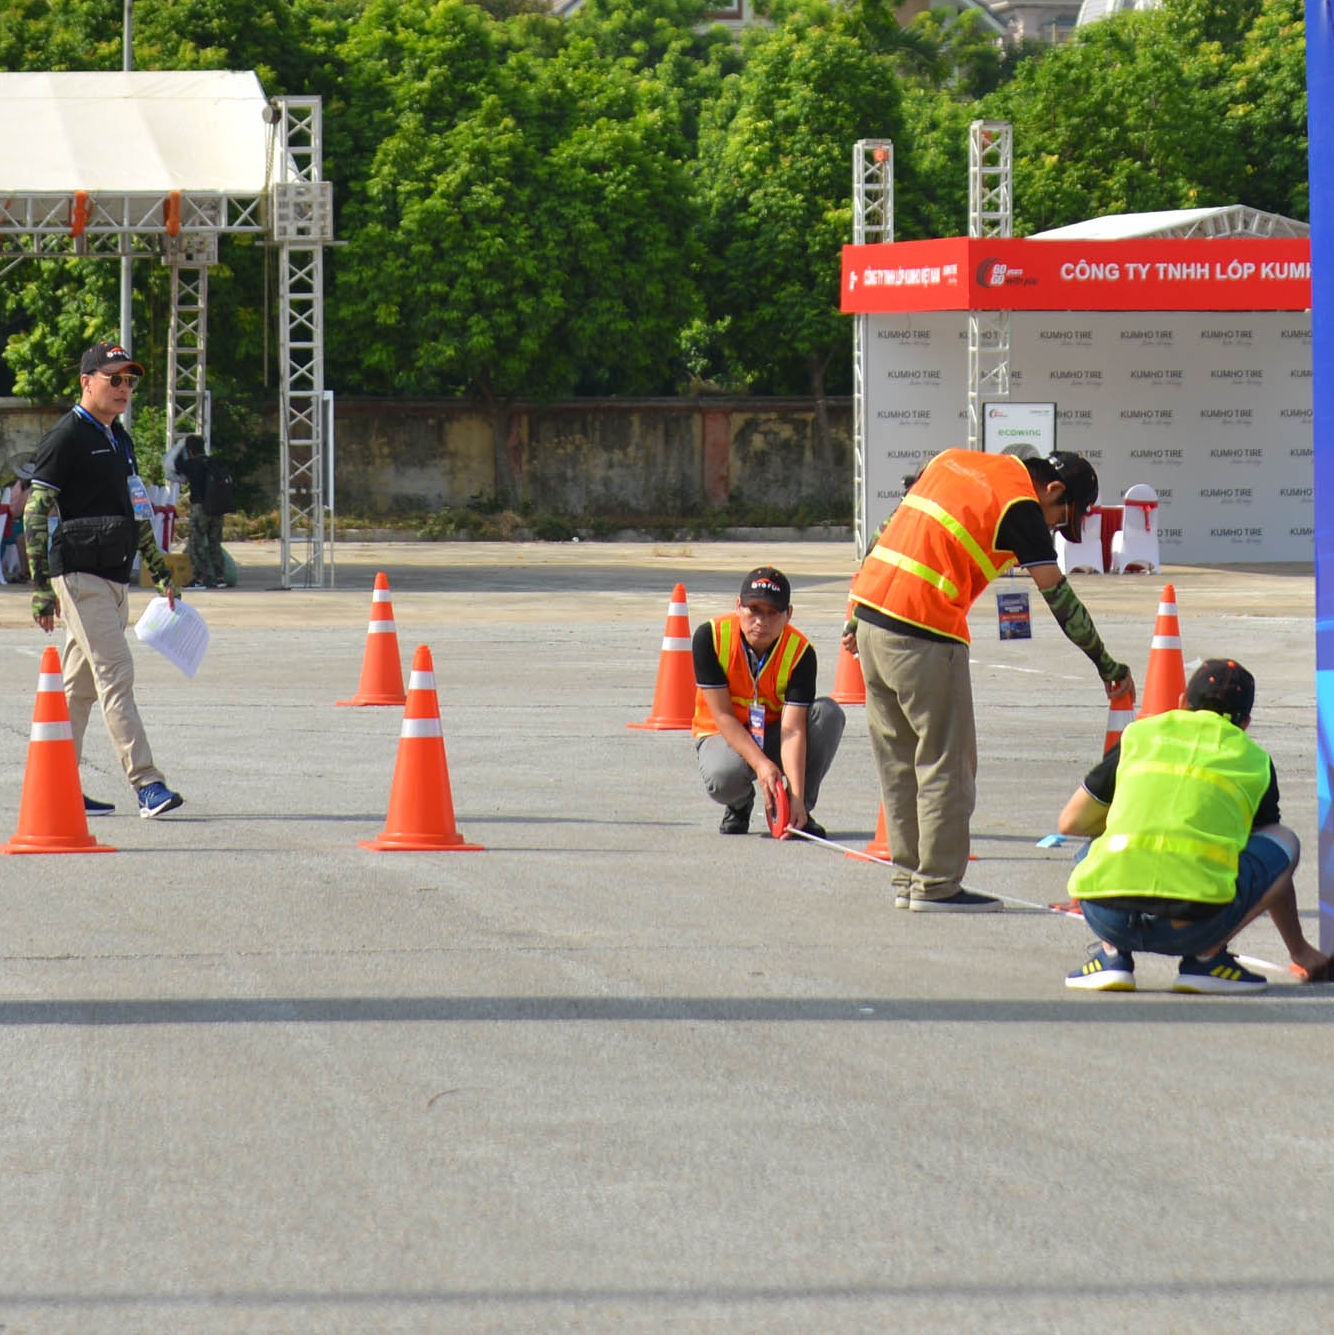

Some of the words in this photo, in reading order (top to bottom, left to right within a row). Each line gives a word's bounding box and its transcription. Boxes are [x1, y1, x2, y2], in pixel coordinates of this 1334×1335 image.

[1060, 259, 1120, 280] CÔNG
[1125, 262, 1151, 280] TY
[1155, 262, 1210, 280] TNHH
[1216, 259, 1256, 280] LỐP
[1120, 330, 1154, 340] KUMHO
[1155, 330, 1173, 340] TIRE
[1201, 330, 1234, 339] KUMHO
[1235, 330, 1254, 339] TIRE
